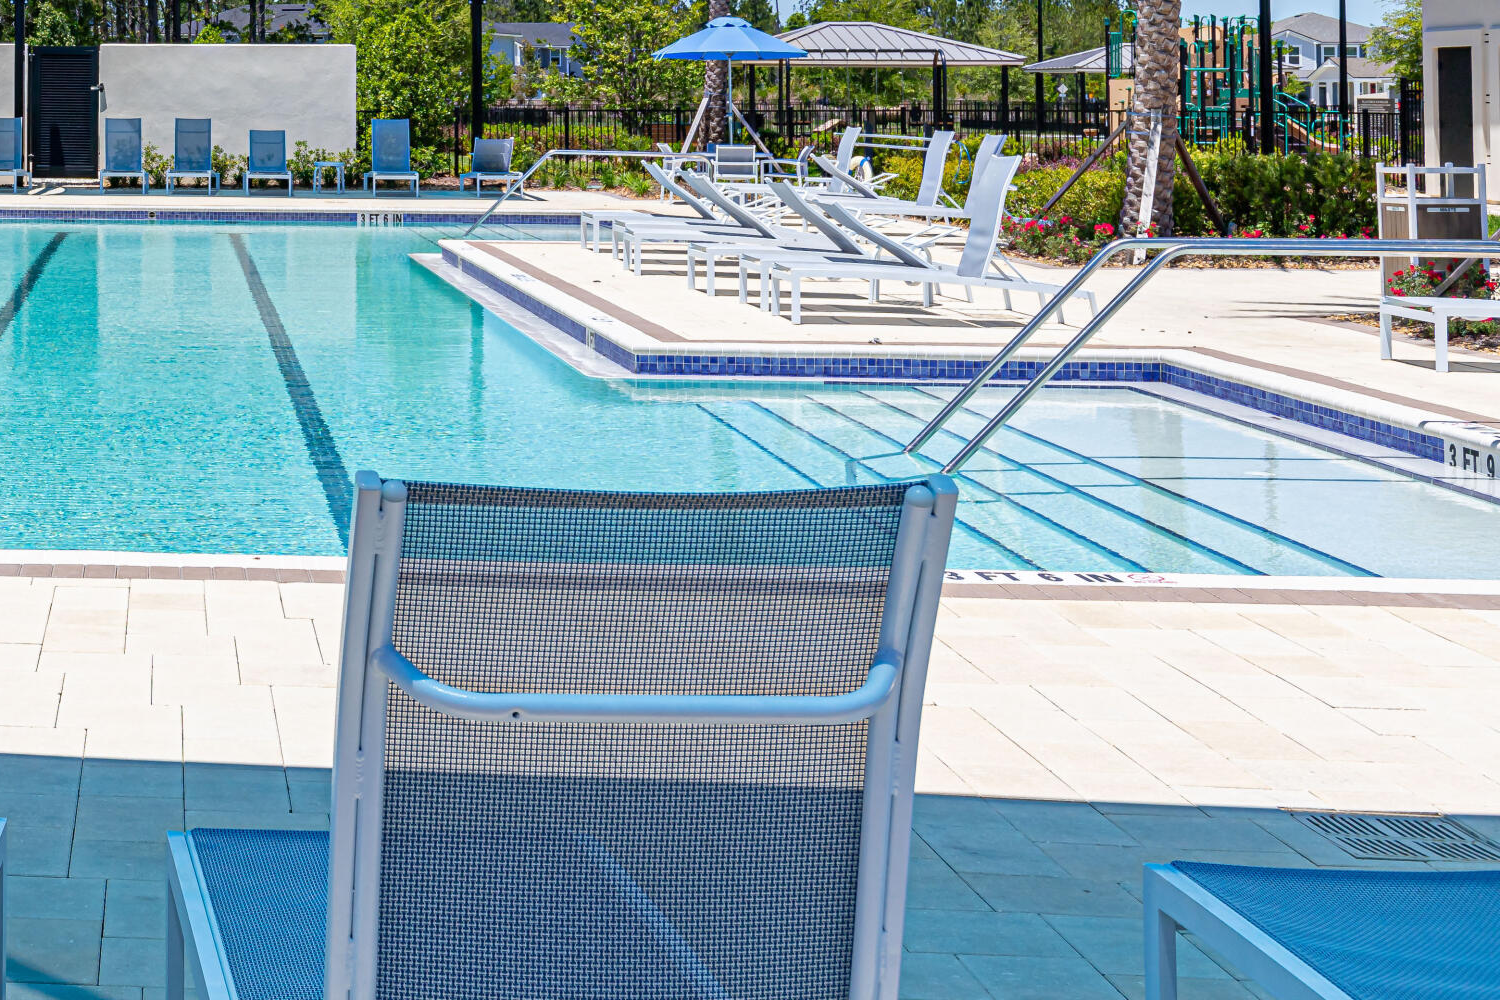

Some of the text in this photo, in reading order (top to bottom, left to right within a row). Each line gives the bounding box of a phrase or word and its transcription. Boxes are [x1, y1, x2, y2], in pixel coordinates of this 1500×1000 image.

[360, 213, 366, 226] 3
[369, 213, 380, 227] FT
[392, 213, 403, 227] IN
[1448, 443, 1495, 478] 3 FT 9
[944, 571, 1124, 583] 3 FT 6 IN
